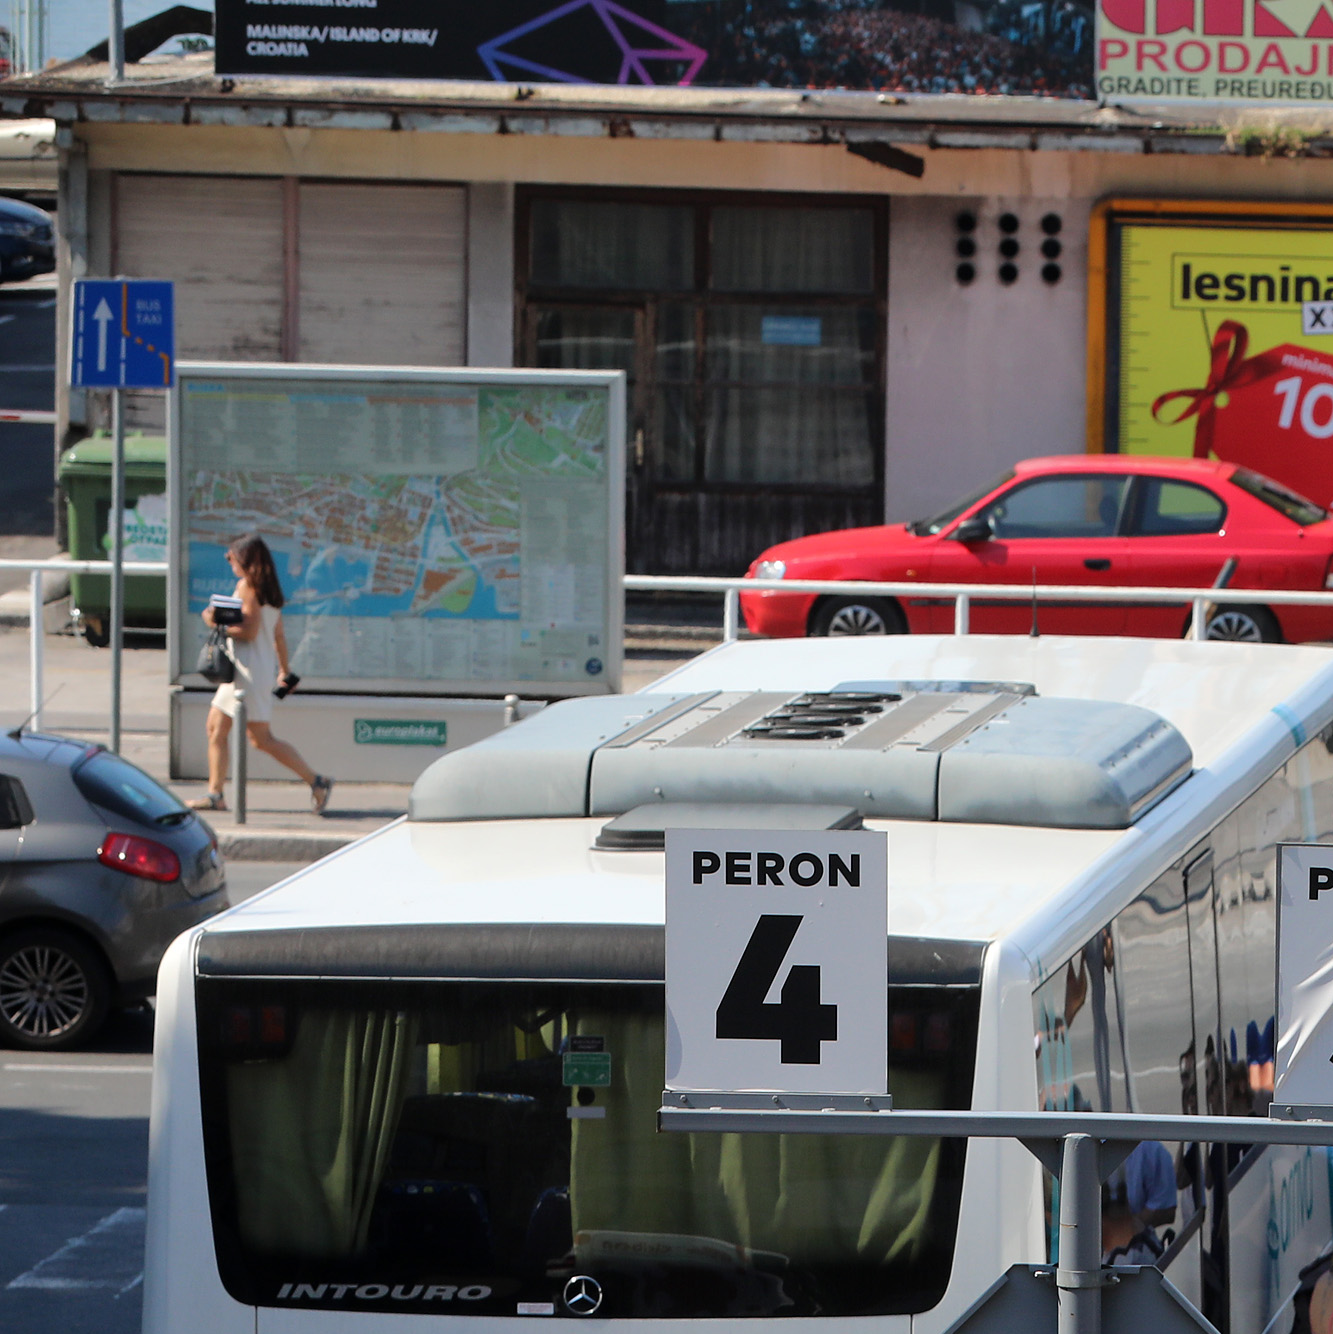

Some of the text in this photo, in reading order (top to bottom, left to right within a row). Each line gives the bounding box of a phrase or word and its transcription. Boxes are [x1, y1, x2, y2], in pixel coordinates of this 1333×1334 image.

[246, 24, 438, 46] MALINSKA/ ISLAND OF KRK/
[246, 41, 309, 56] CROATIA
[1100, 75, 1207, 97] GRADITE,
[135, 300, 161, 312] BUS
[692, 850, 862, 888] PERON
[715, 914, 838, 1065] 4
[276, 1282, 493, 1301] INTOURO
